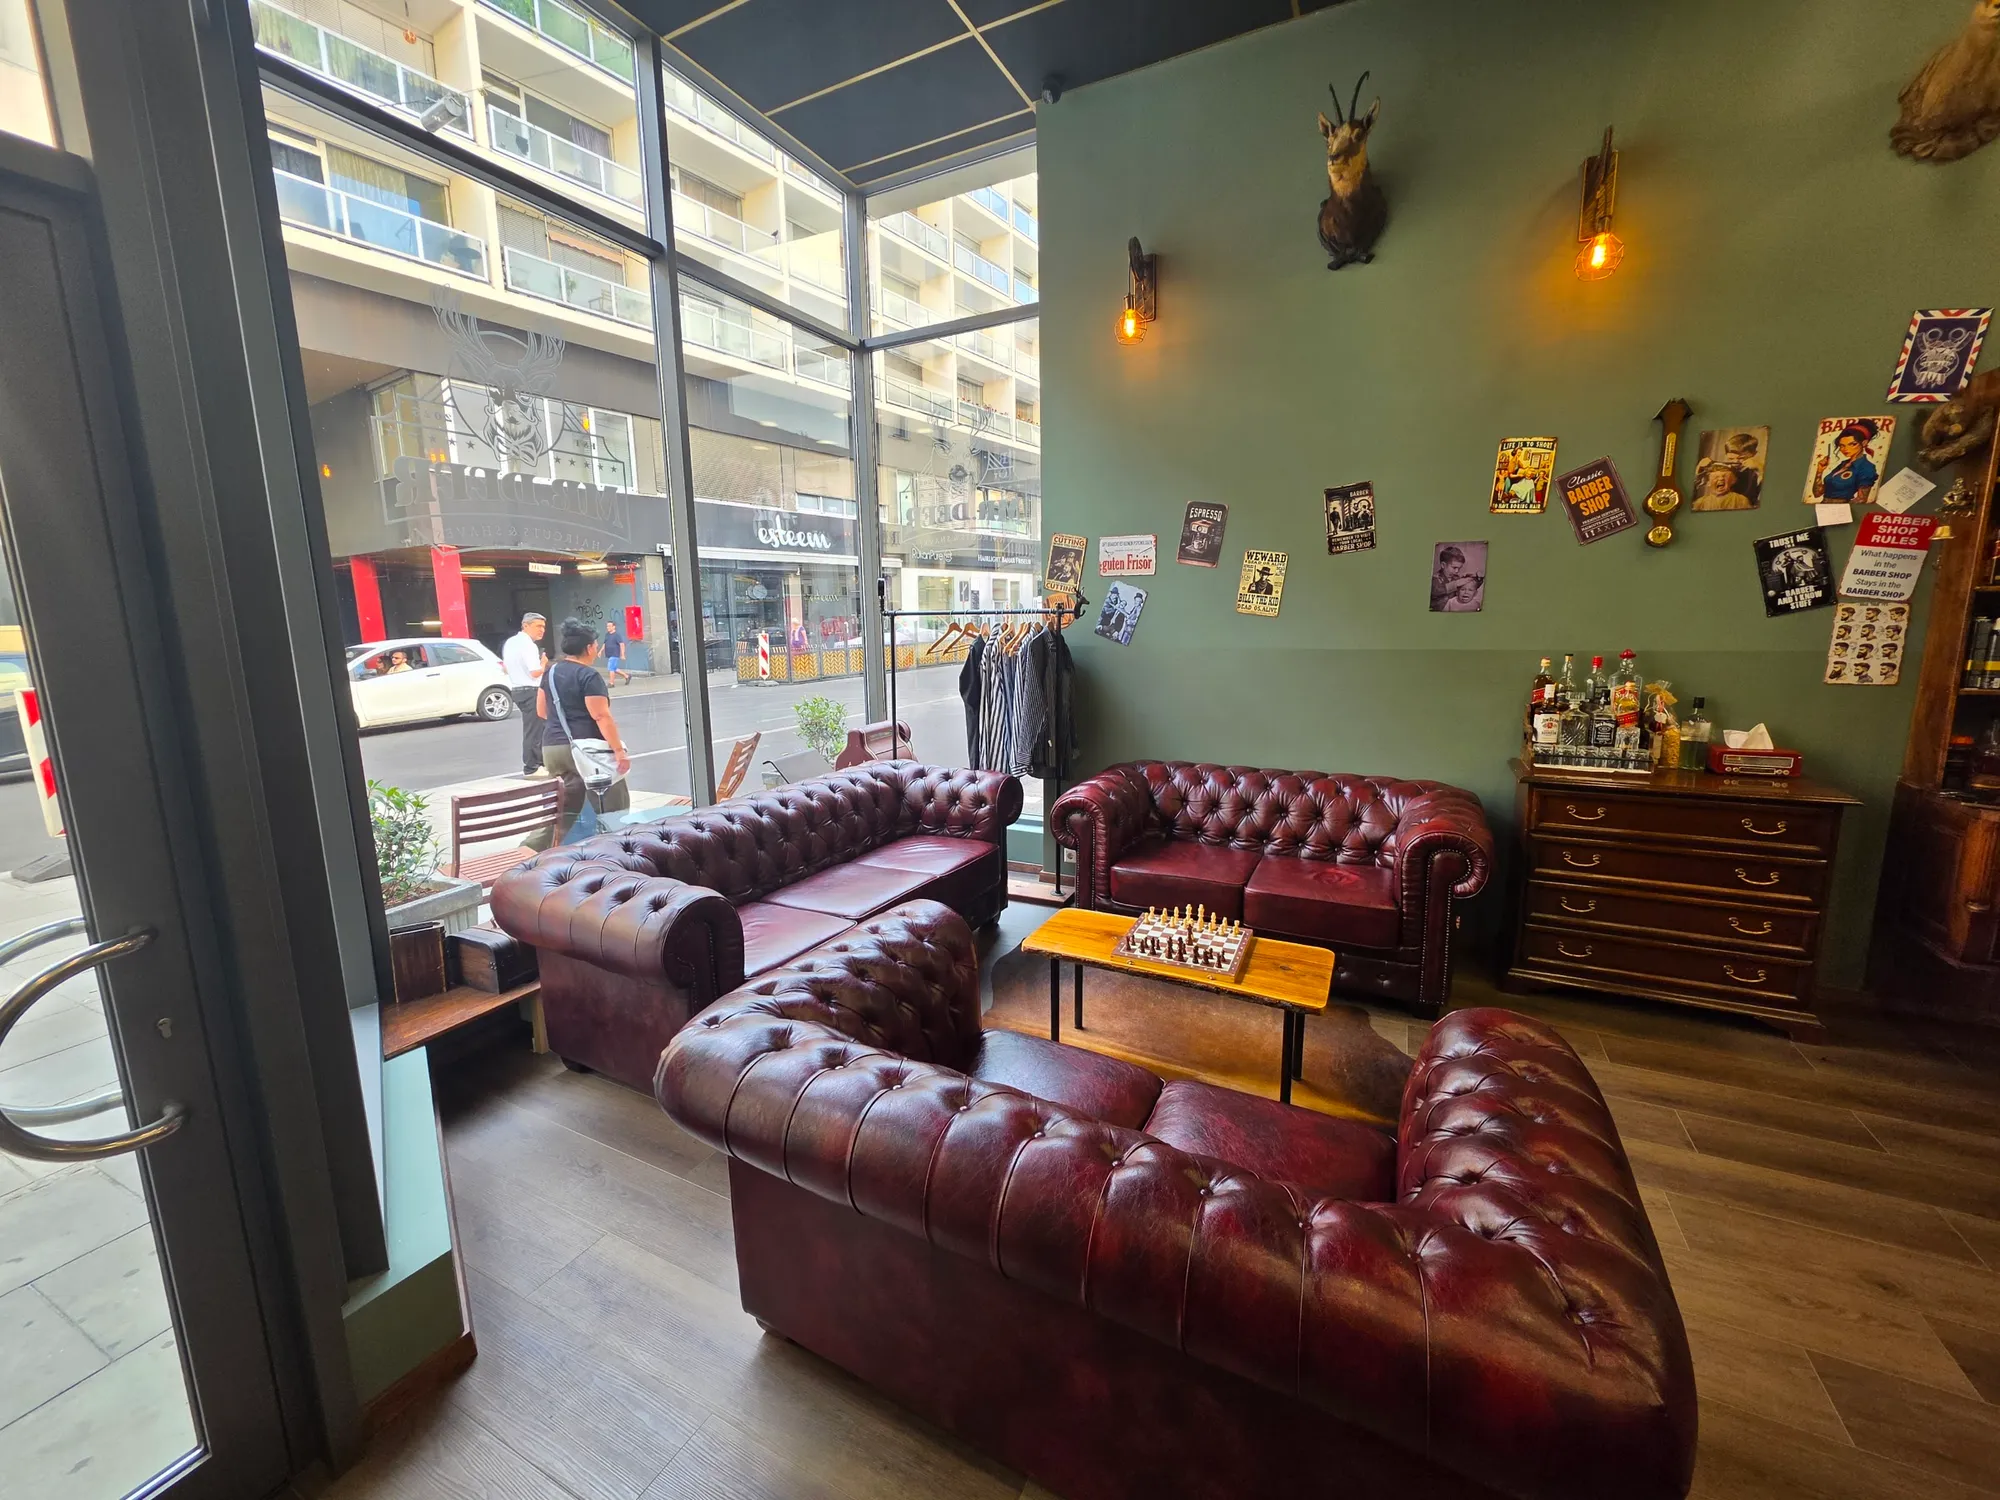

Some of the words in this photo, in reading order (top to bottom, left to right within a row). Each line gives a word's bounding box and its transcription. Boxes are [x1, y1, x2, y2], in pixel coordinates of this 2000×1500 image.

[1503, 442, 1515, 450] LIFE
[1536, 441, 1553, 450] SHORT
[1567, 469, 1604, 489] Classic
[1567, 475, 1614, 505] BARBER
[1580, 492, 1611, 516] SHOP
[1190, 507, 1222, 521] ESPRESSO
[1872, 515, 1931, 526] BARBER
[758, 514, 832, 549] esteem
[1877, 525, 1919, 535] SHOP
[1053, 536, 1085, 547] CUTTING
[1768, 535, 1795, 548] TRUST
[1796, 533, 1810, 542] ME
[1871, 534, 1919, 545] RULES
[1246, 551, 1287, 563] WEWARD
[1861, 550, 1883, 558] What
[1883, 551, 1918, 561] happens
[1102, 557, 1125, 573] guten
[1127, 554, 1152, 570] Frisör
[1874, 560, 1882, 568] in
[1852, 568, 1887, 578] BARBER
[1888, 571, 1912, 580] SHOP
[1855, 578, 1878, 588] Stays
[1879, 579, 1886, 587] in
[1888, 580, 1901, 588] the
[1778, 596, 1793, 606] AND
[1799, 590, 1822, 601] KNOW
[1845, 587, 1880, 596] BARBER
[1881, 589, 1905, 598] SHOP
[1238, 593, 1255, 604] BILLY
[1256, 595, 1268, 606] THE
[1268, 596, 1279, 607] KID
[1790, 599, 1812, 610] STUFF
